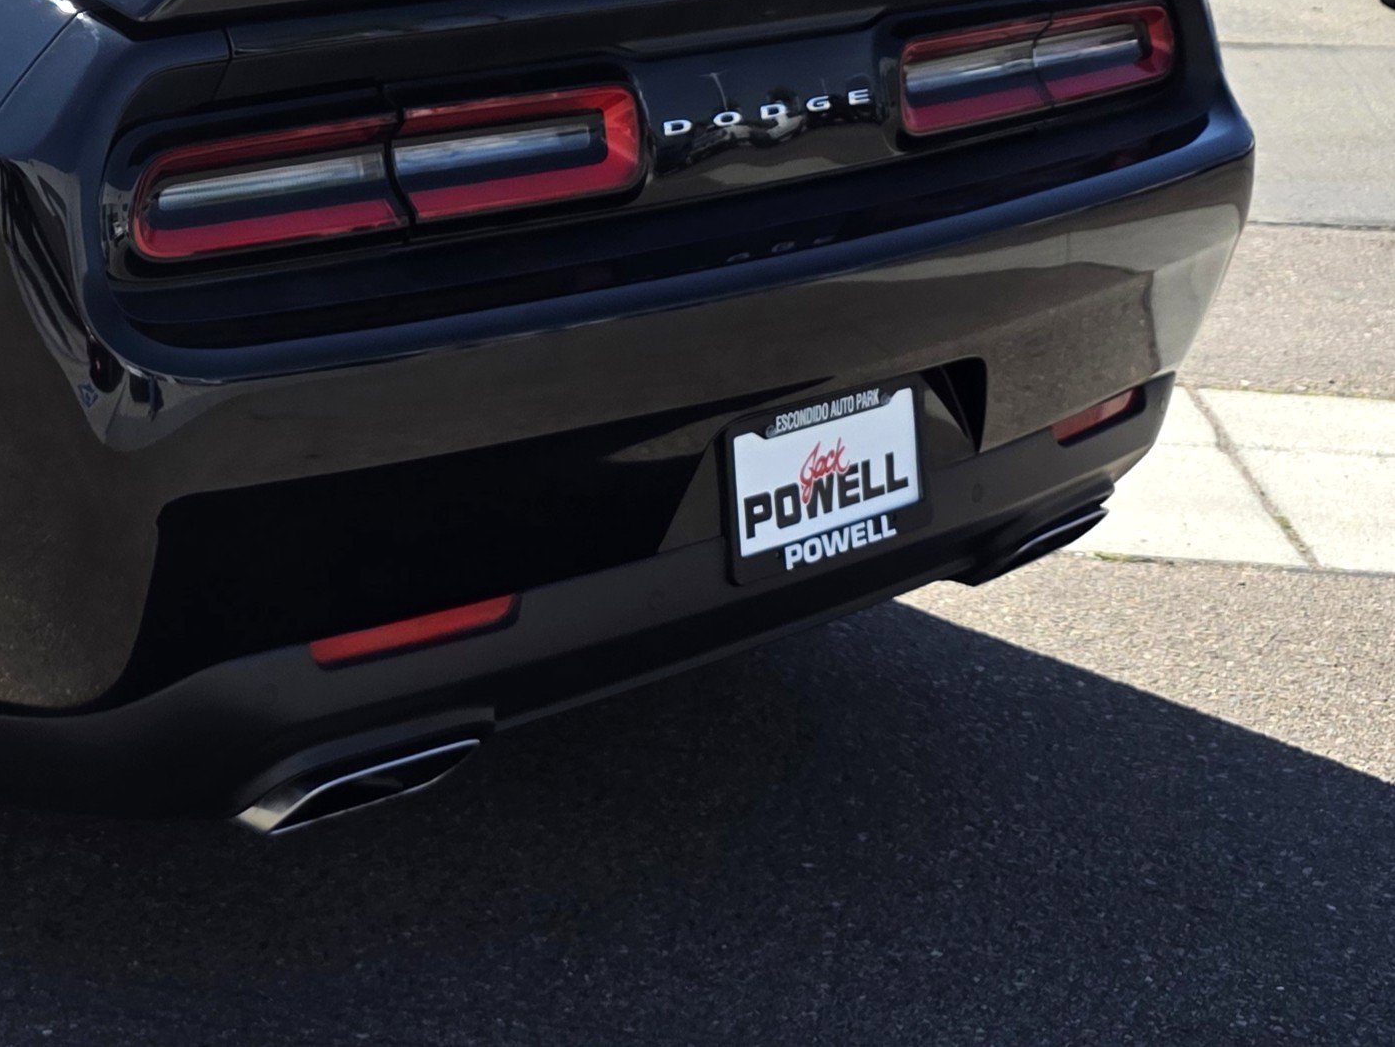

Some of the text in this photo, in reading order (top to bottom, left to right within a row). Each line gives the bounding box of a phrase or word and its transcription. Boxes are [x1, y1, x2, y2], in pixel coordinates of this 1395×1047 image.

[663, 88, 870, 136] DODGE
[775, 388, 880, 432] ESCONDIDO AUTO PARK
[744, 452, 908, 540] POWELL
[799, 437, 850, 504] Jack
[785, 515, 897, 570] POWELL
